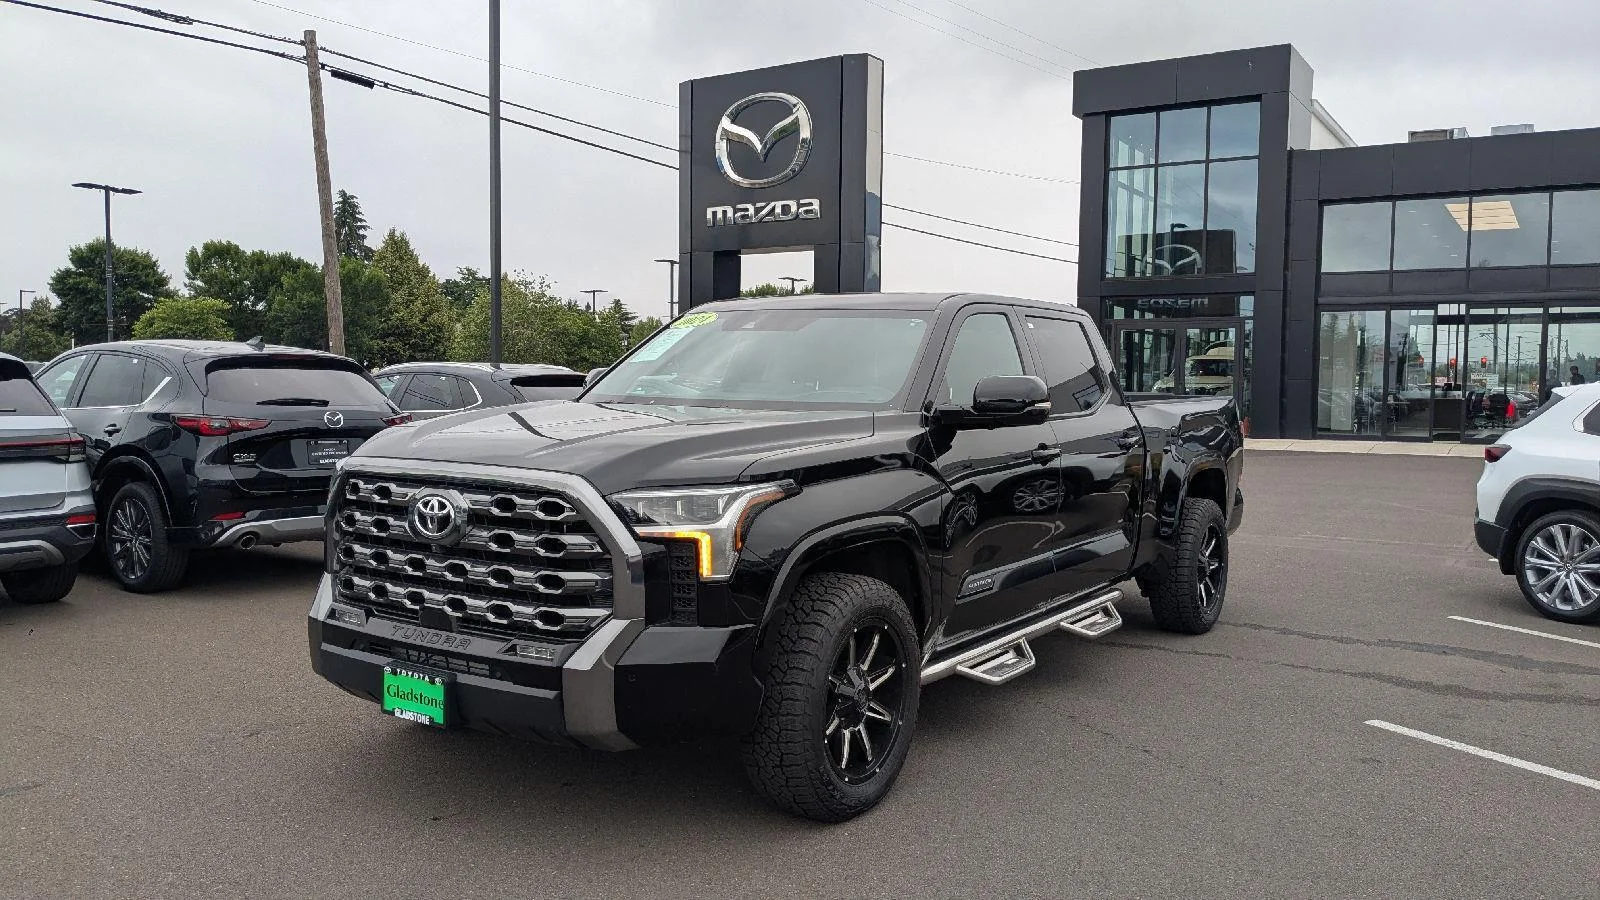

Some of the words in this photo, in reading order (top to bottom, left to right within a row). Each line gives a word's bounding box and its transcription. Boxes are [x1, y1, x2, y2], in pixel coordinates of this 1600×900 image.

[391, 625, 472, 651] TUNDRA
[396, 668, 430, 682] TOYOTA
[386, 684, 444, 710] Gladstone
[394, 708, 430, 725] GLADSTONE
